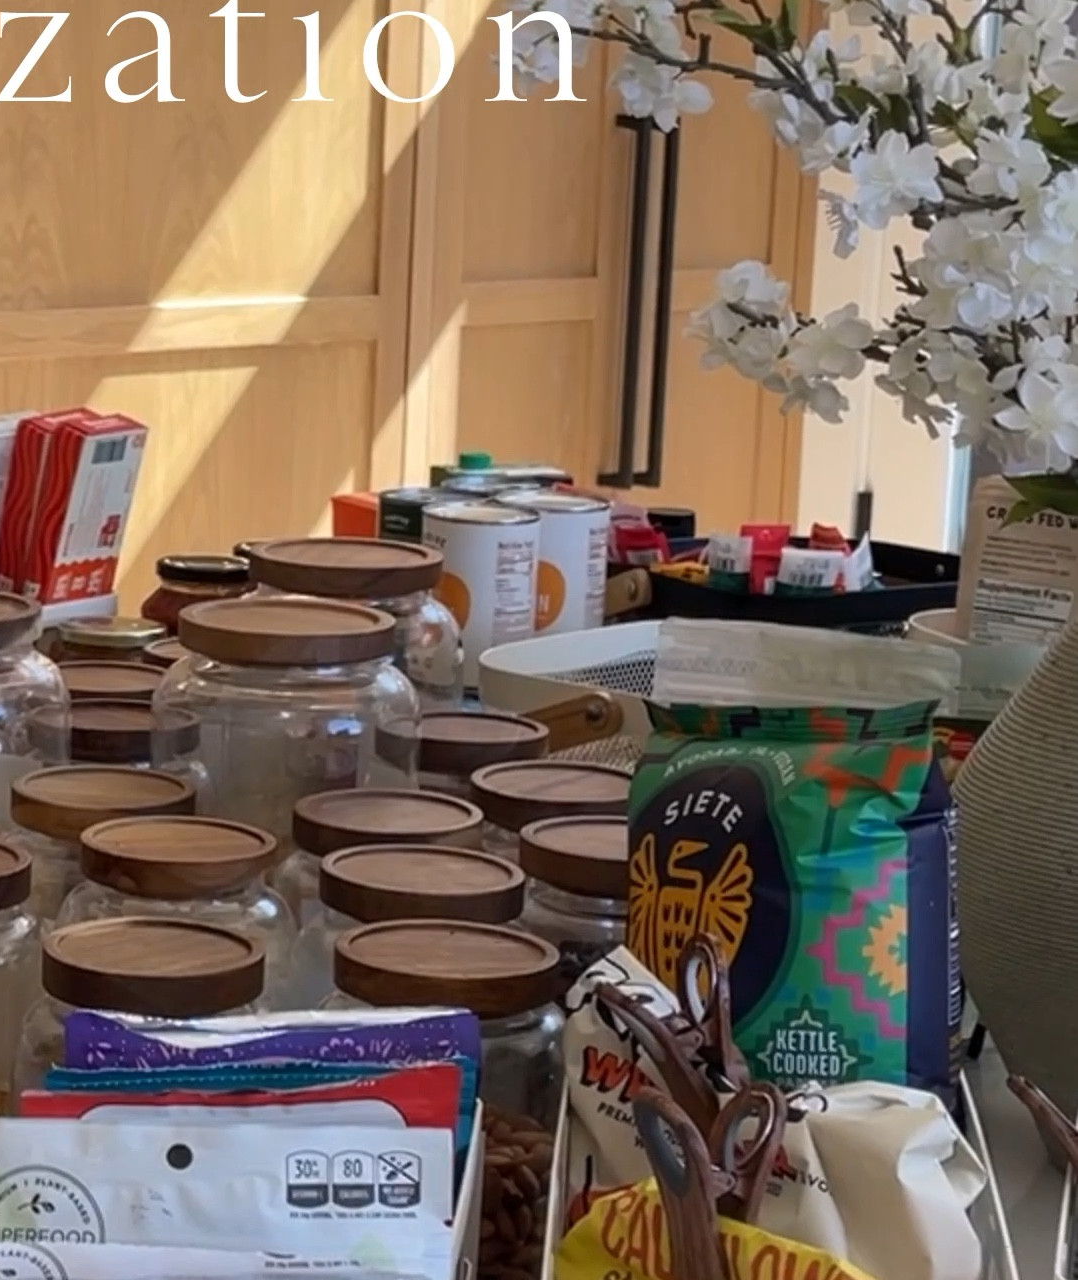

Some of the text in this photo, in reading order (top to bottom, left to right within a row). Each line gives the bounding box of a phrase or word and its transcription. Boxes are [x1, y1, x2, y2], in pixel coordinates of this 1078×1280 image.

[664, 790, 744, 833] SIETE
[775, 1028, 838, 1053] KETTLE
[773, 1052, 840, 1077] COOKED
[35, 1177, 91, 1226] PLANT-BASED
